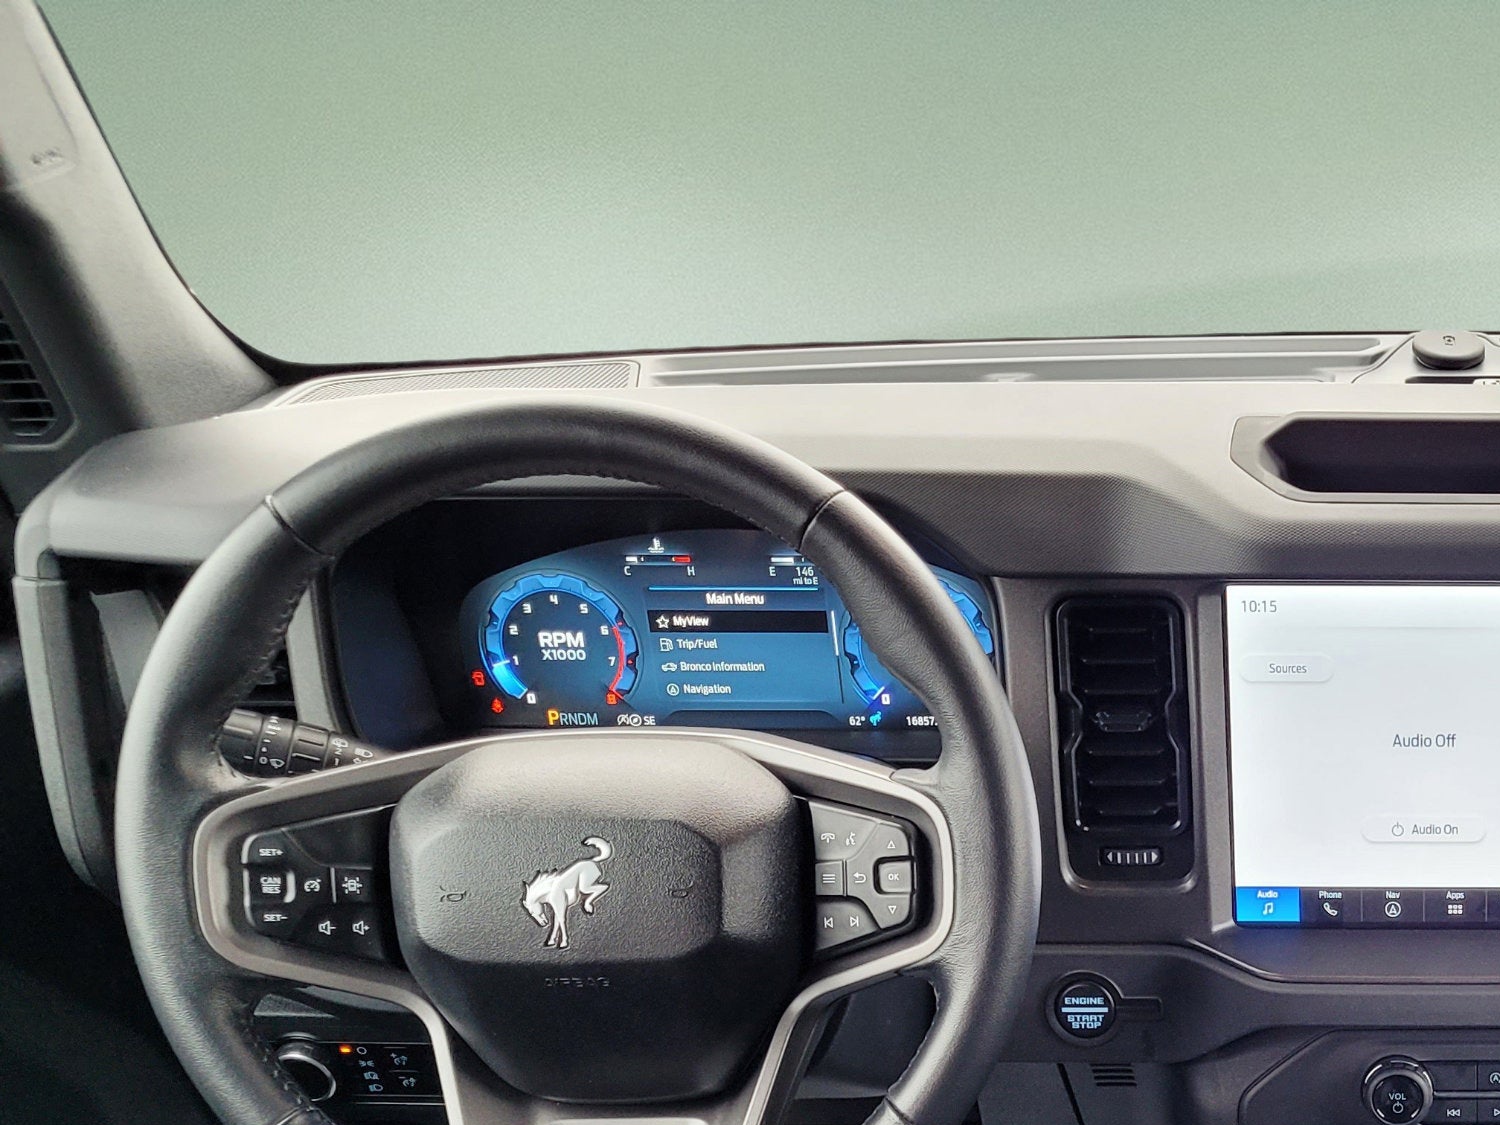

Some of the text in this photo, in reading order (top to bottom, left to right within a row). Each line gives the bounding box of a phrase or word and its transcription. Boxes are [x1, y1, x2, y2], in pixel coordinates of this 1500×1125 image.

[624, 566, 632, 576] C
[687, 566, 696, 576] H
[769, 566, 776, 577] E
[795, 566, 814, 577] 146
[813, 577, 819, 585] E
[549, 594, 559, 605] 4
[706, 593, 765, 605] Main Menu
[522, 603, 532, 614] 3
[579, 603, 589, 614] 5
[1240, 600, 1278, 613] 10:15
[672, 615, 710, 628] MyView
[509, 625, 519, 636] 2
[600, 625, 609, 636] 6
[538, 631, 585, 648] RPM
[676, 638, 718, 650] Trip/Fuel
[513, 655, 520, 665] 1
[542, 650, 587, 661] X1000
[608, 657, 616, 666] 7
[680, 661, 766, 672] Bronco Information
[1268, 663, 1307, 674] Sources
[683, 683, 732, 696] Navigation
[643, 716, 656, 726] SE
[848, 716, 866, 726] 62°
[1392, 733, 1457, 748] Audio Off
[1411, 824, 1459, 835] Audio On
[260, 876, 282, 885] CAN
[887, 873, 900, 881] OK
[262, 885, 281, 894] RES
[1256, 890, 1279, 899] Audio
[1318, 890, 1342, 899] Phone
[1385, 890, 1401, 899] Nav
[1445, 890, 1465, 900] Apps
[1064, 996, 1105, 1005] ENGINE
[1067, 1014, 1105, 1022] START
[1071, 1021, 1102, 1029] STOP
[1388, 1092, 1407, 1101] VOL
